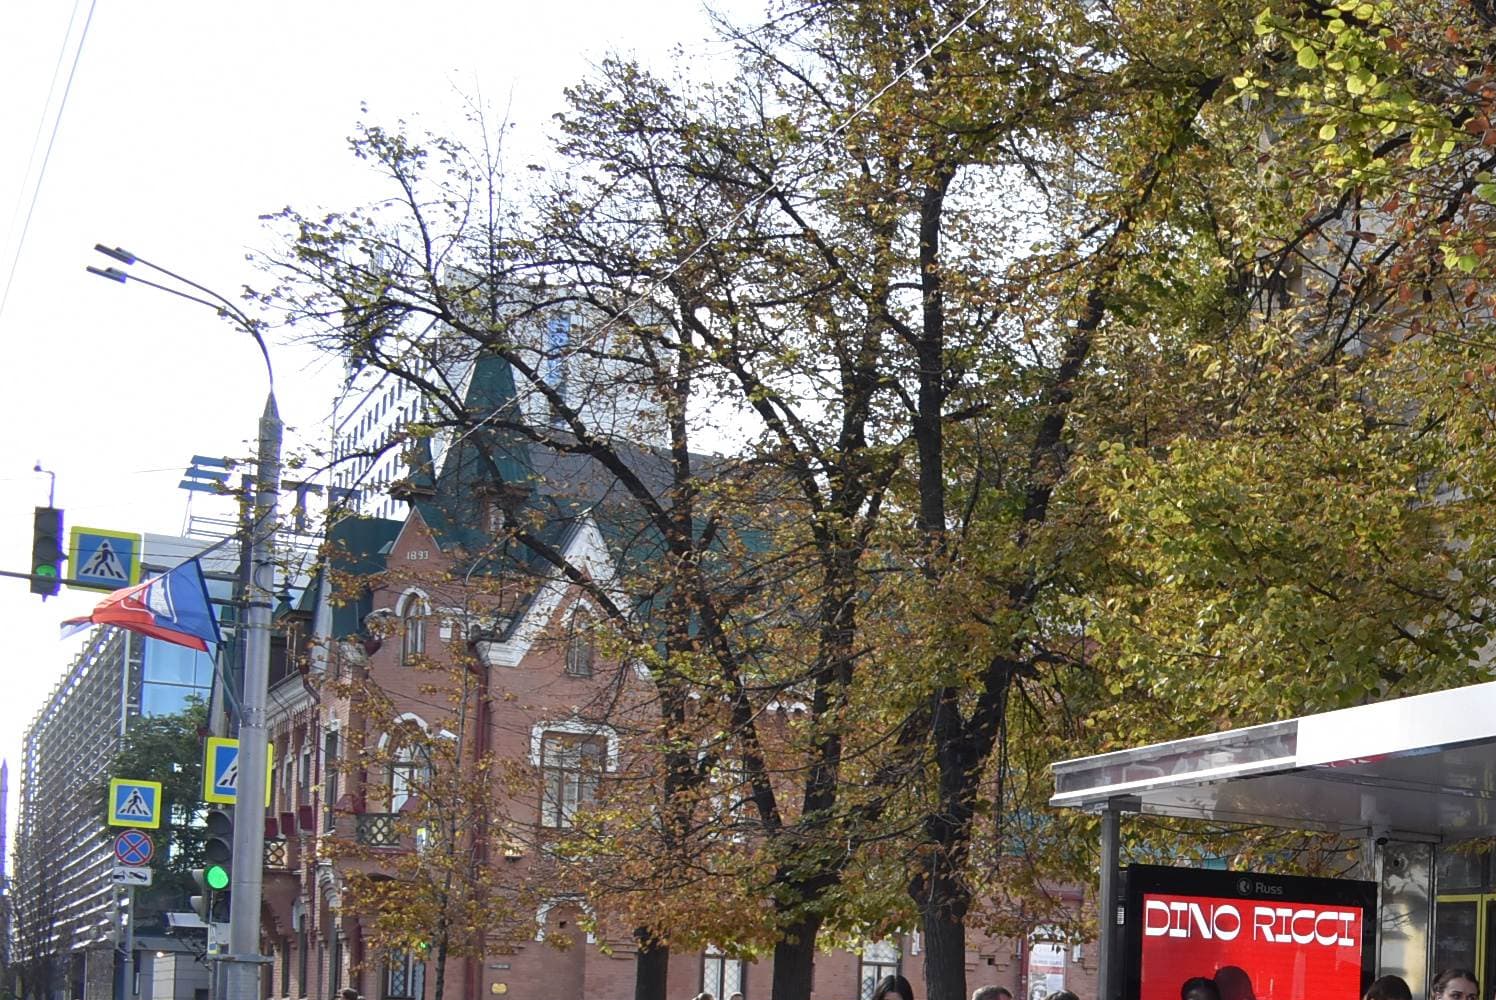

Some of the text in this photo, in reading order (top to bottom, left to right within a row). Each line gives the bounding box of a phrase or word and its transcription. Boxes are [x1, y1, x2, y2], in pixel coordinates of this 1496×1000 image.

[406, 550, 429, 560] 1893
[1255, 881, 1283, 895] Russ
[1145, 900, 1355, 946] DINO RICCI
